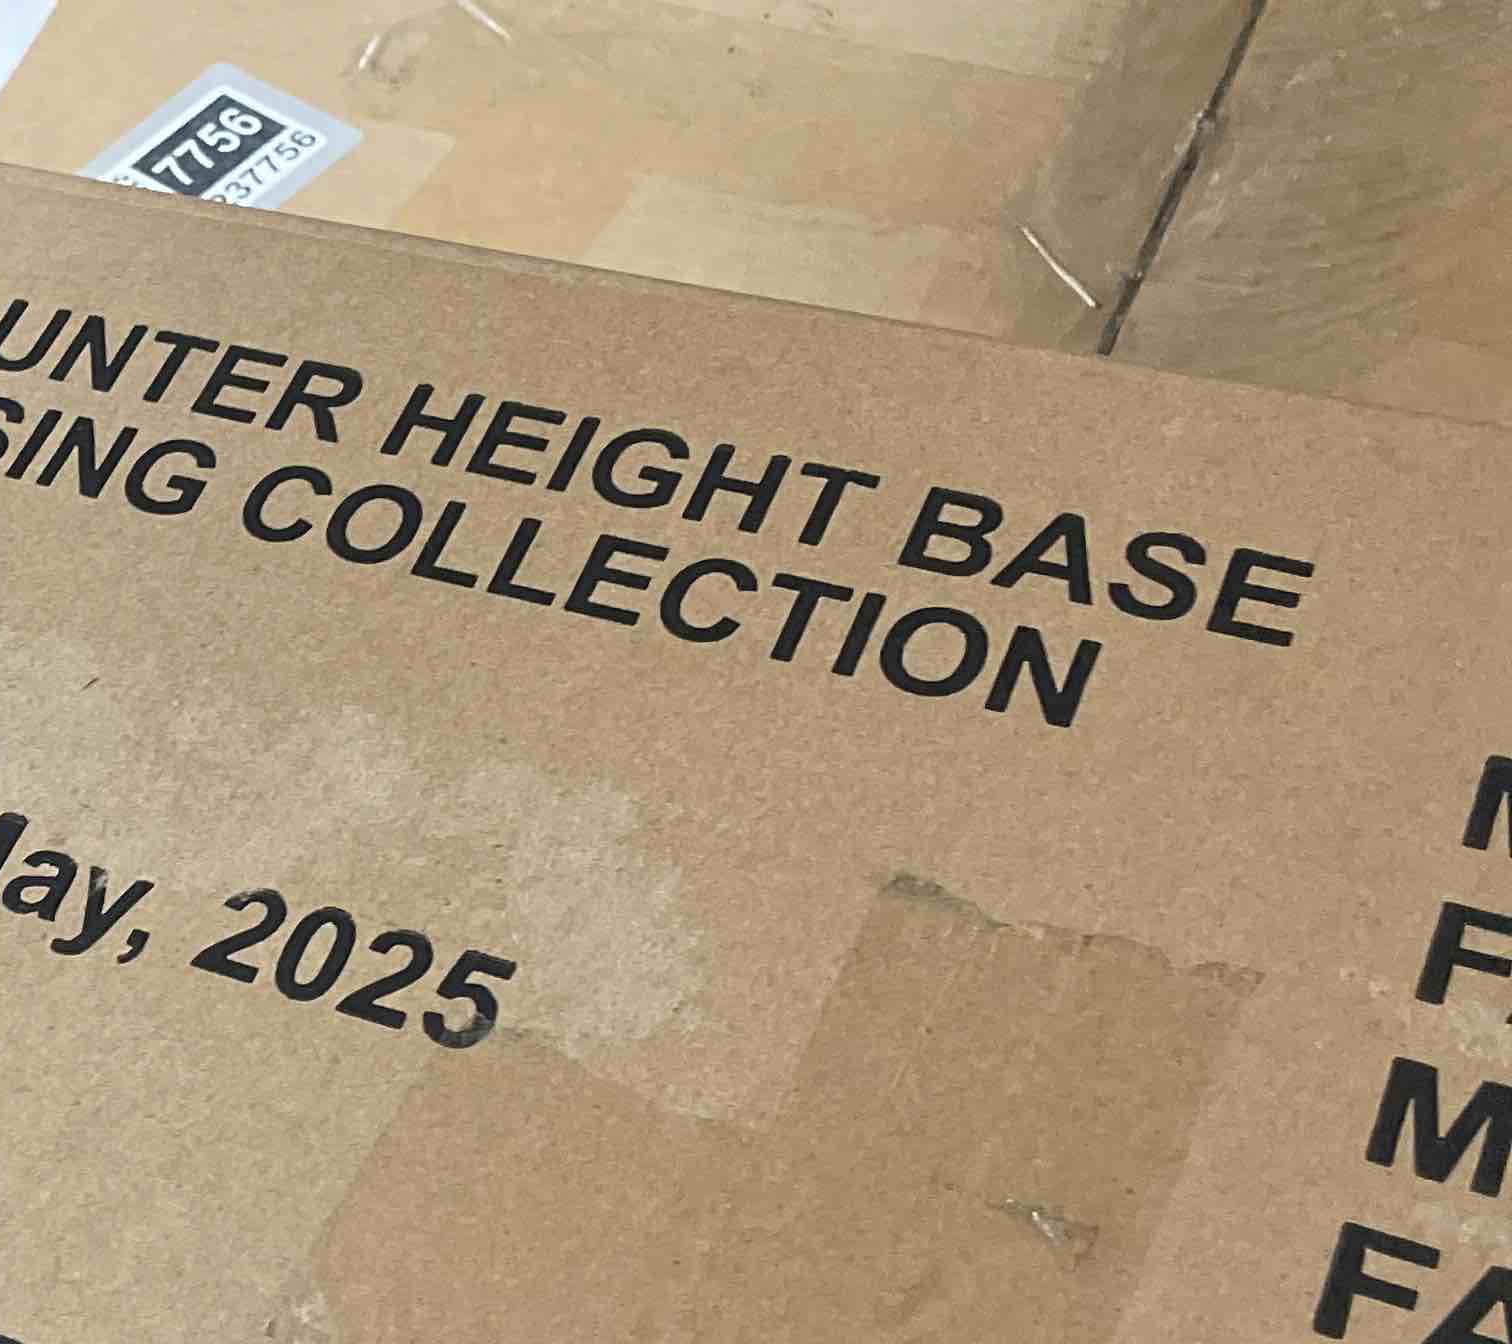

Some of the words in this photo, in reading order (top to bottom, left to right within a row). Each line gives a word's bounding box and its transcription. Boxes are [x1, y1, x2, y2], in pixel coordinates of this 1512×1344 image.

[151, 107, 263, 186] 7756
[242, 464, 1103, 728] COLLECTION
[381, 383, 881, 546] HEIGHT
[898, 485, 1315, 647] BASE
[190, 886, 517, 1049] 2025
